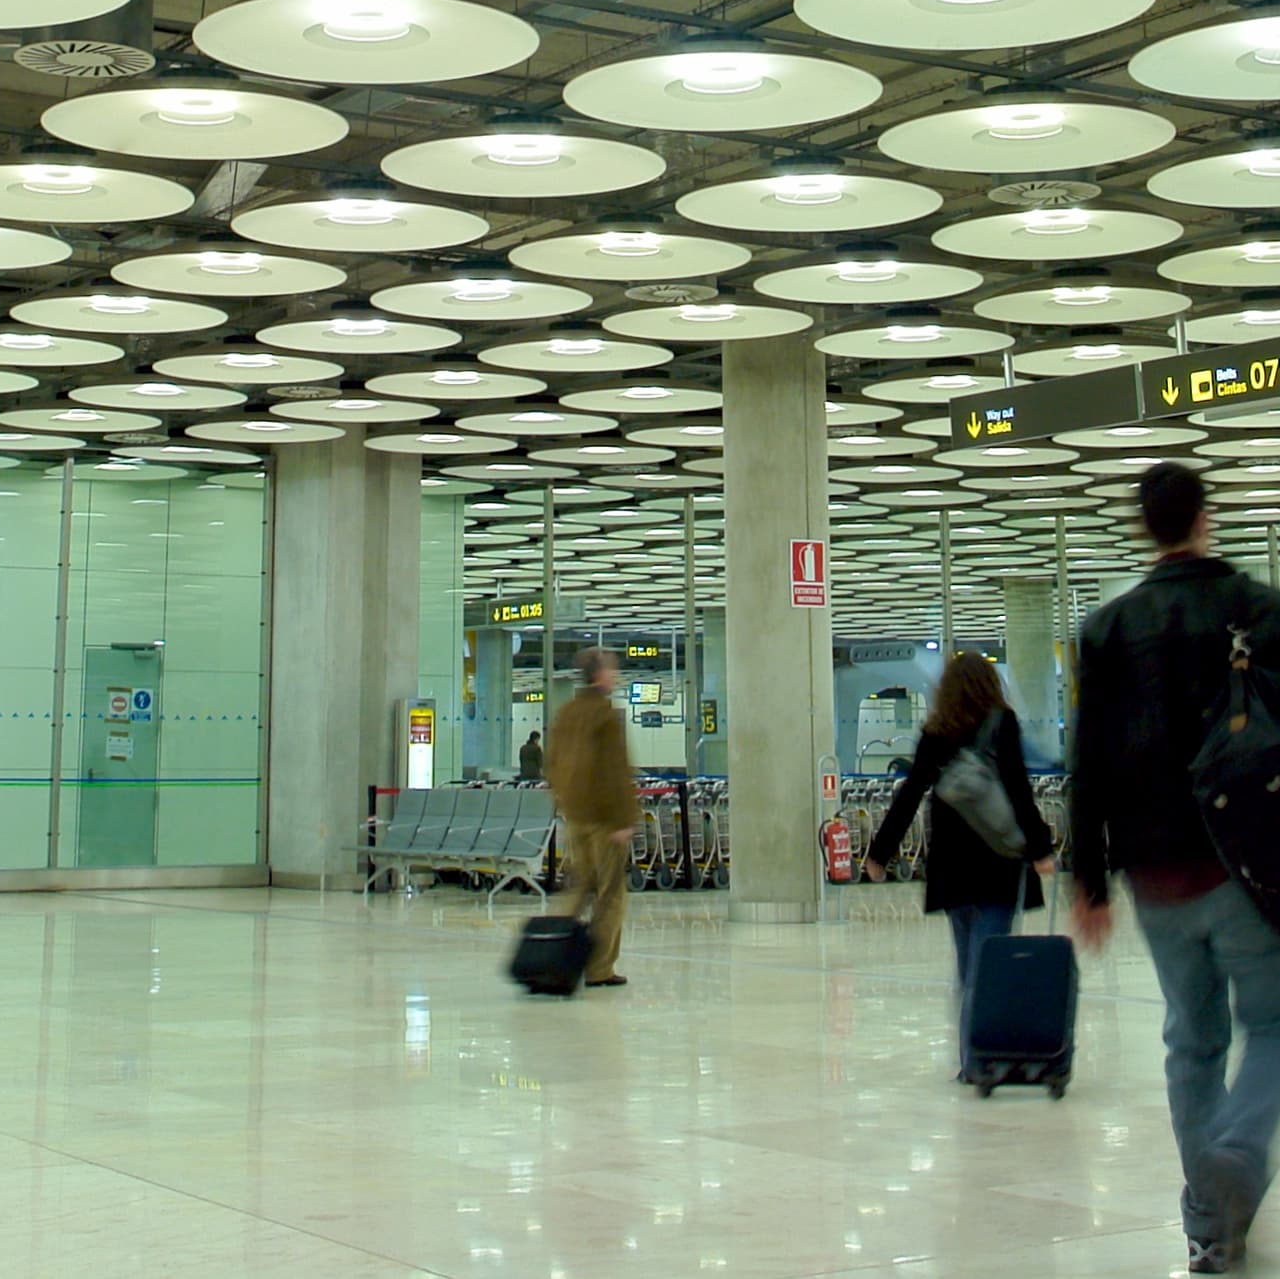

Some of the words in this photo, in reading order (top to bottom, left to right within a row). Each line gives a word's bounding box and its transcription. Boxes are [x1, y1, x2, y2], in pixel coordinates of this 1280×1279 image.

[1216, 368, 1238, 381] Belts
[1250, 359, 1279, 389] 07
[1217, 381, 1248, 396] Cintas
[987, 420, 1012, 435] Salida
